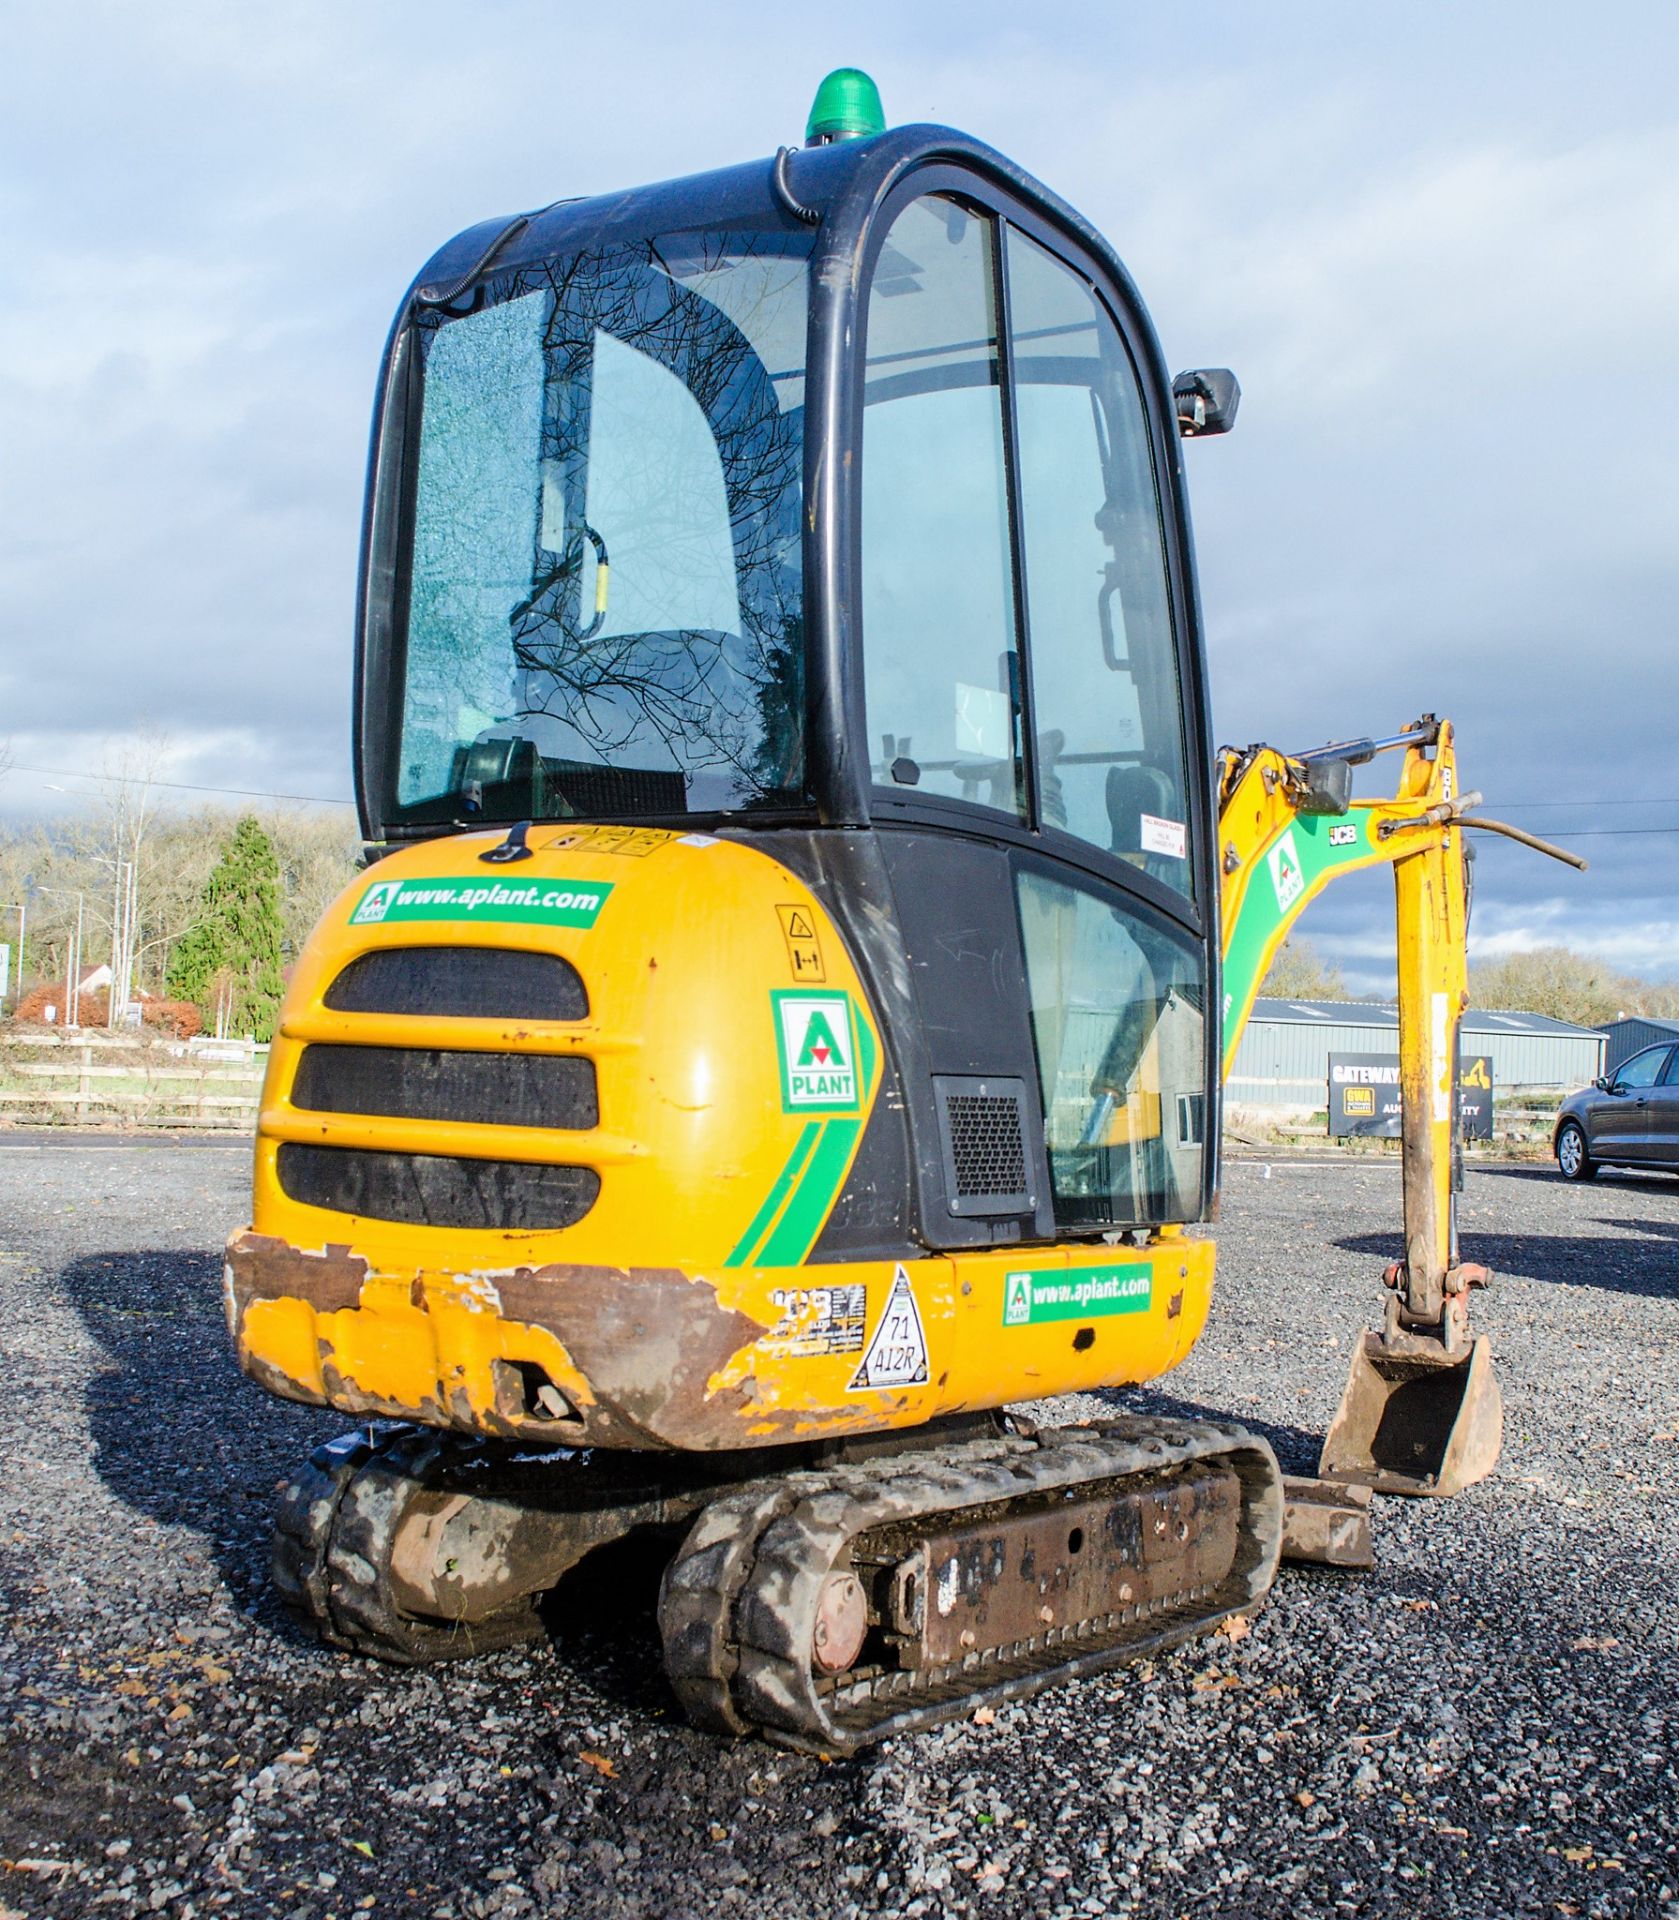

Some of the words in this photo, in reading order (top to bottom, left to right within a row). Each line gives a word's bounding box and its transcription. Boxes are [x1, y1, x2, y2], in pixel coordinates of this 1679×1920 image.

[1330, 825, 1356, 846] JCB
[366, 887, 389, 907] A
[396, 883, 600, 911] www.aplant.com
[357, 909, 385, 919] PLANT
[797, 1010, 846, 1066] A
[1333, 1065, 1401, 1083] GATEWAY
[792, 1075, 851, 1096] PLANT
[1011, 1279, 1028, 1306] A
[1033, 1275, 1150, 1308] www.aplant.com
[1008, 1309, 1029, 1320] PLANT
[891, 1316, 908, 1341] 71
